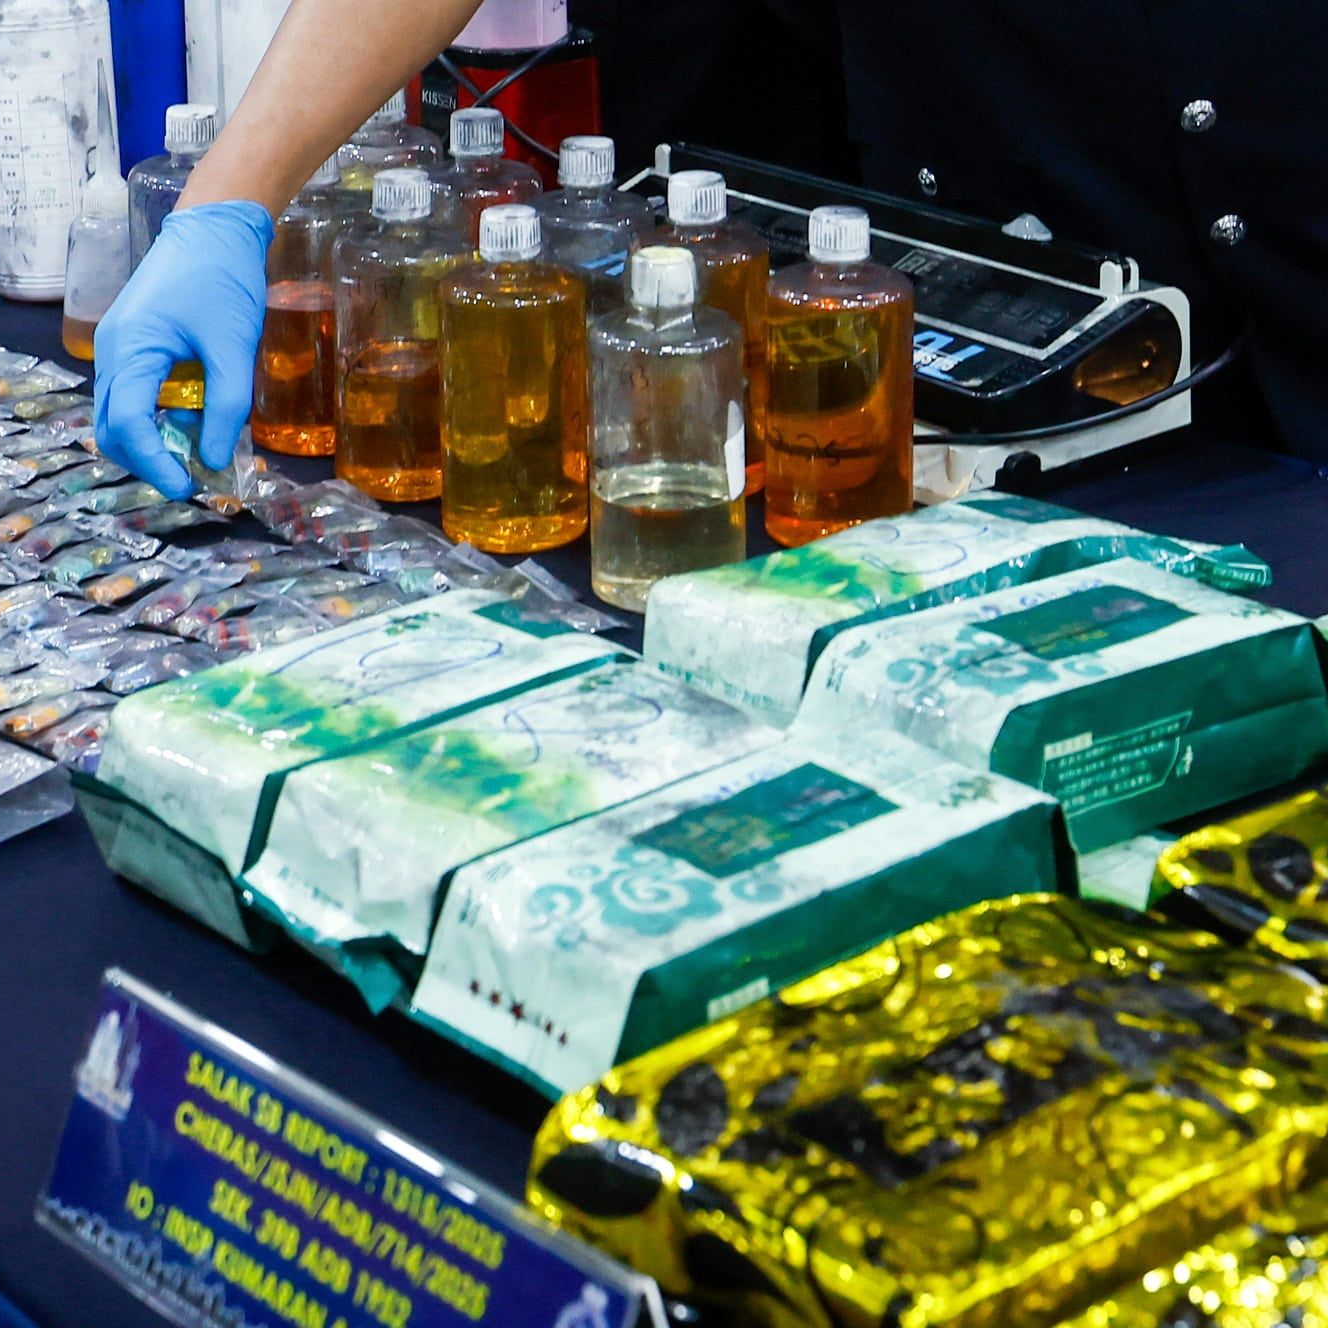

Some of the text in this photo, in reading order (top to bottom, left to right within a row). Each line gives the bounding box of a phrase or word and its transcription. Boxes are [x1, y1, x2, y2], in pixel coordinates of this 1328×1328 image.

[422, 89, 457, 111] KISSEN
[184, 1051, 255, 1117] SALAK
[282, 1111, 368, 1183] REPORT
[125, 1178, 155, 1220] IO
[212, 1239, 329, 1328] KUMARAN
